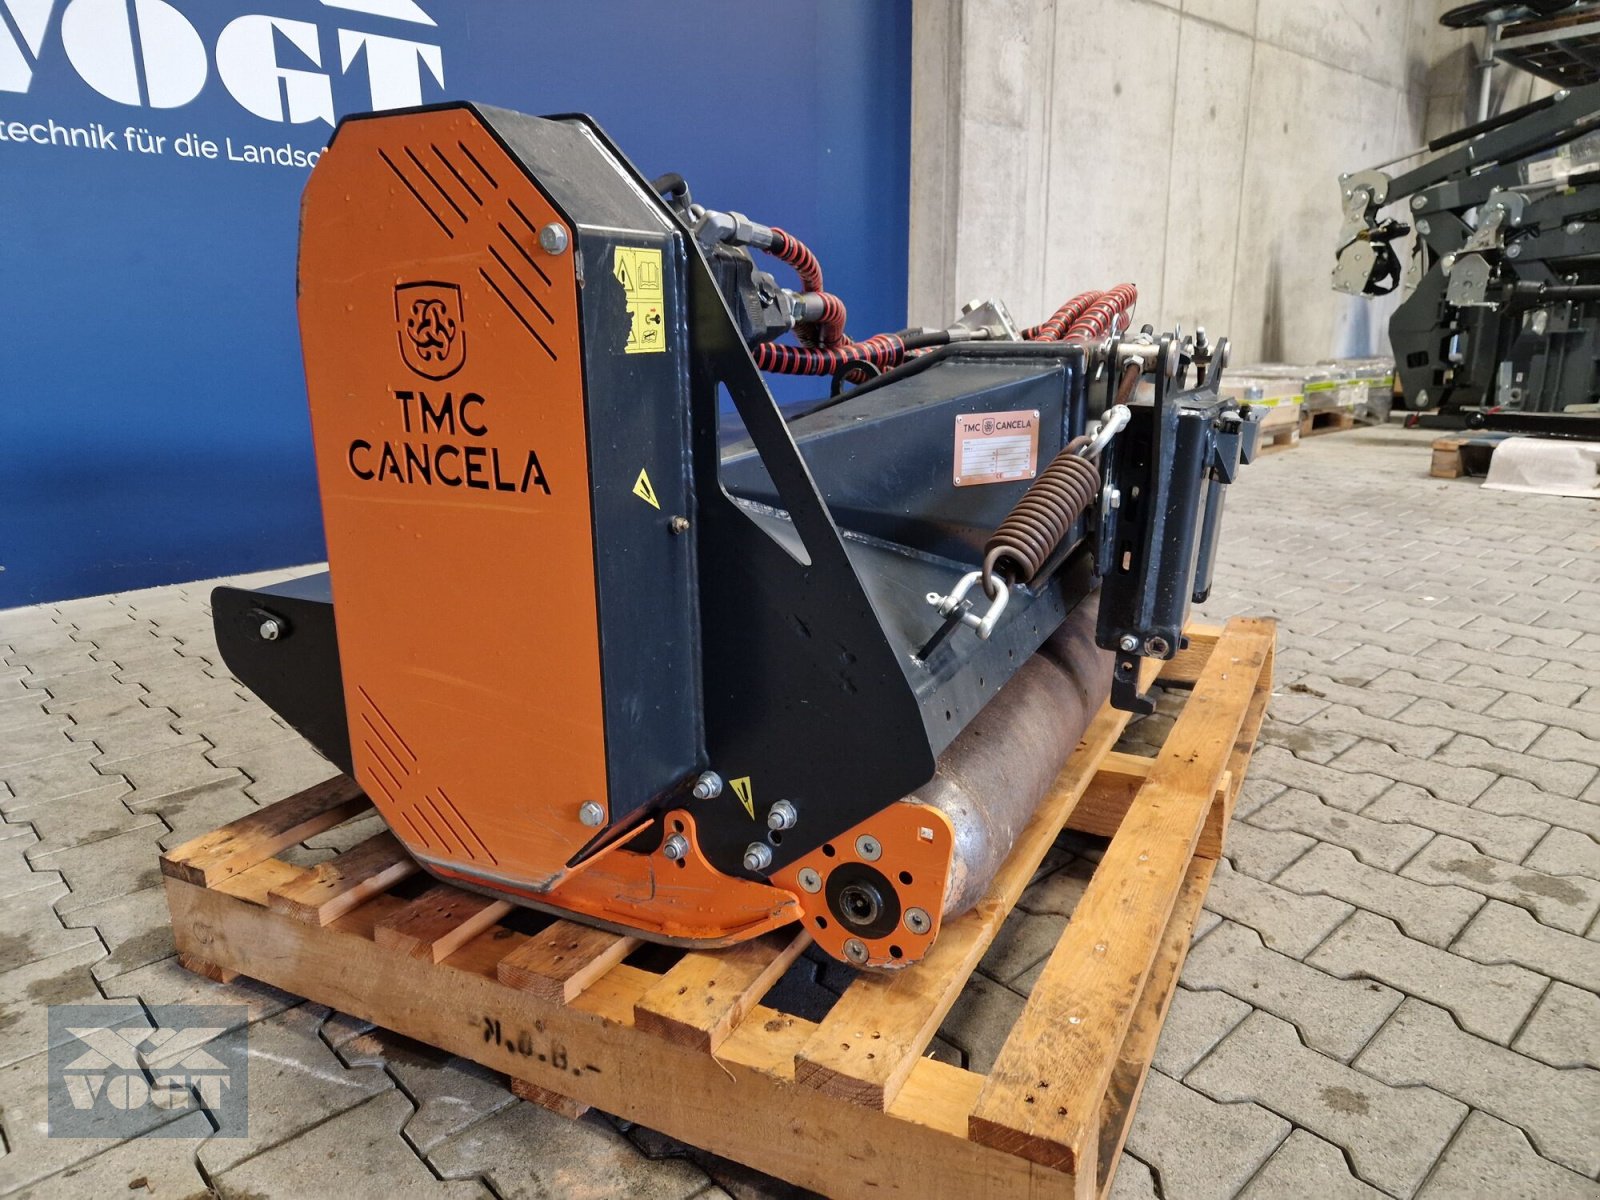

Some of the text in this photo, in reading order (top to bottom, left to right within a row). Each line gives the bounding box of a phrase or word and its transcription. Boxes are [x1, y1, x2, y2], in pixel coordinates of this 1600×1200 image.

[124, 126, 167, 155] für
[174, 132, 219, 159] die
[226, 137, 321, 169] Landsc
[394, 391, 488, 437] TMC
[963, 419, 1032, 432] TMC CANCELA
[347, 439, 552, 495] CANCELA
